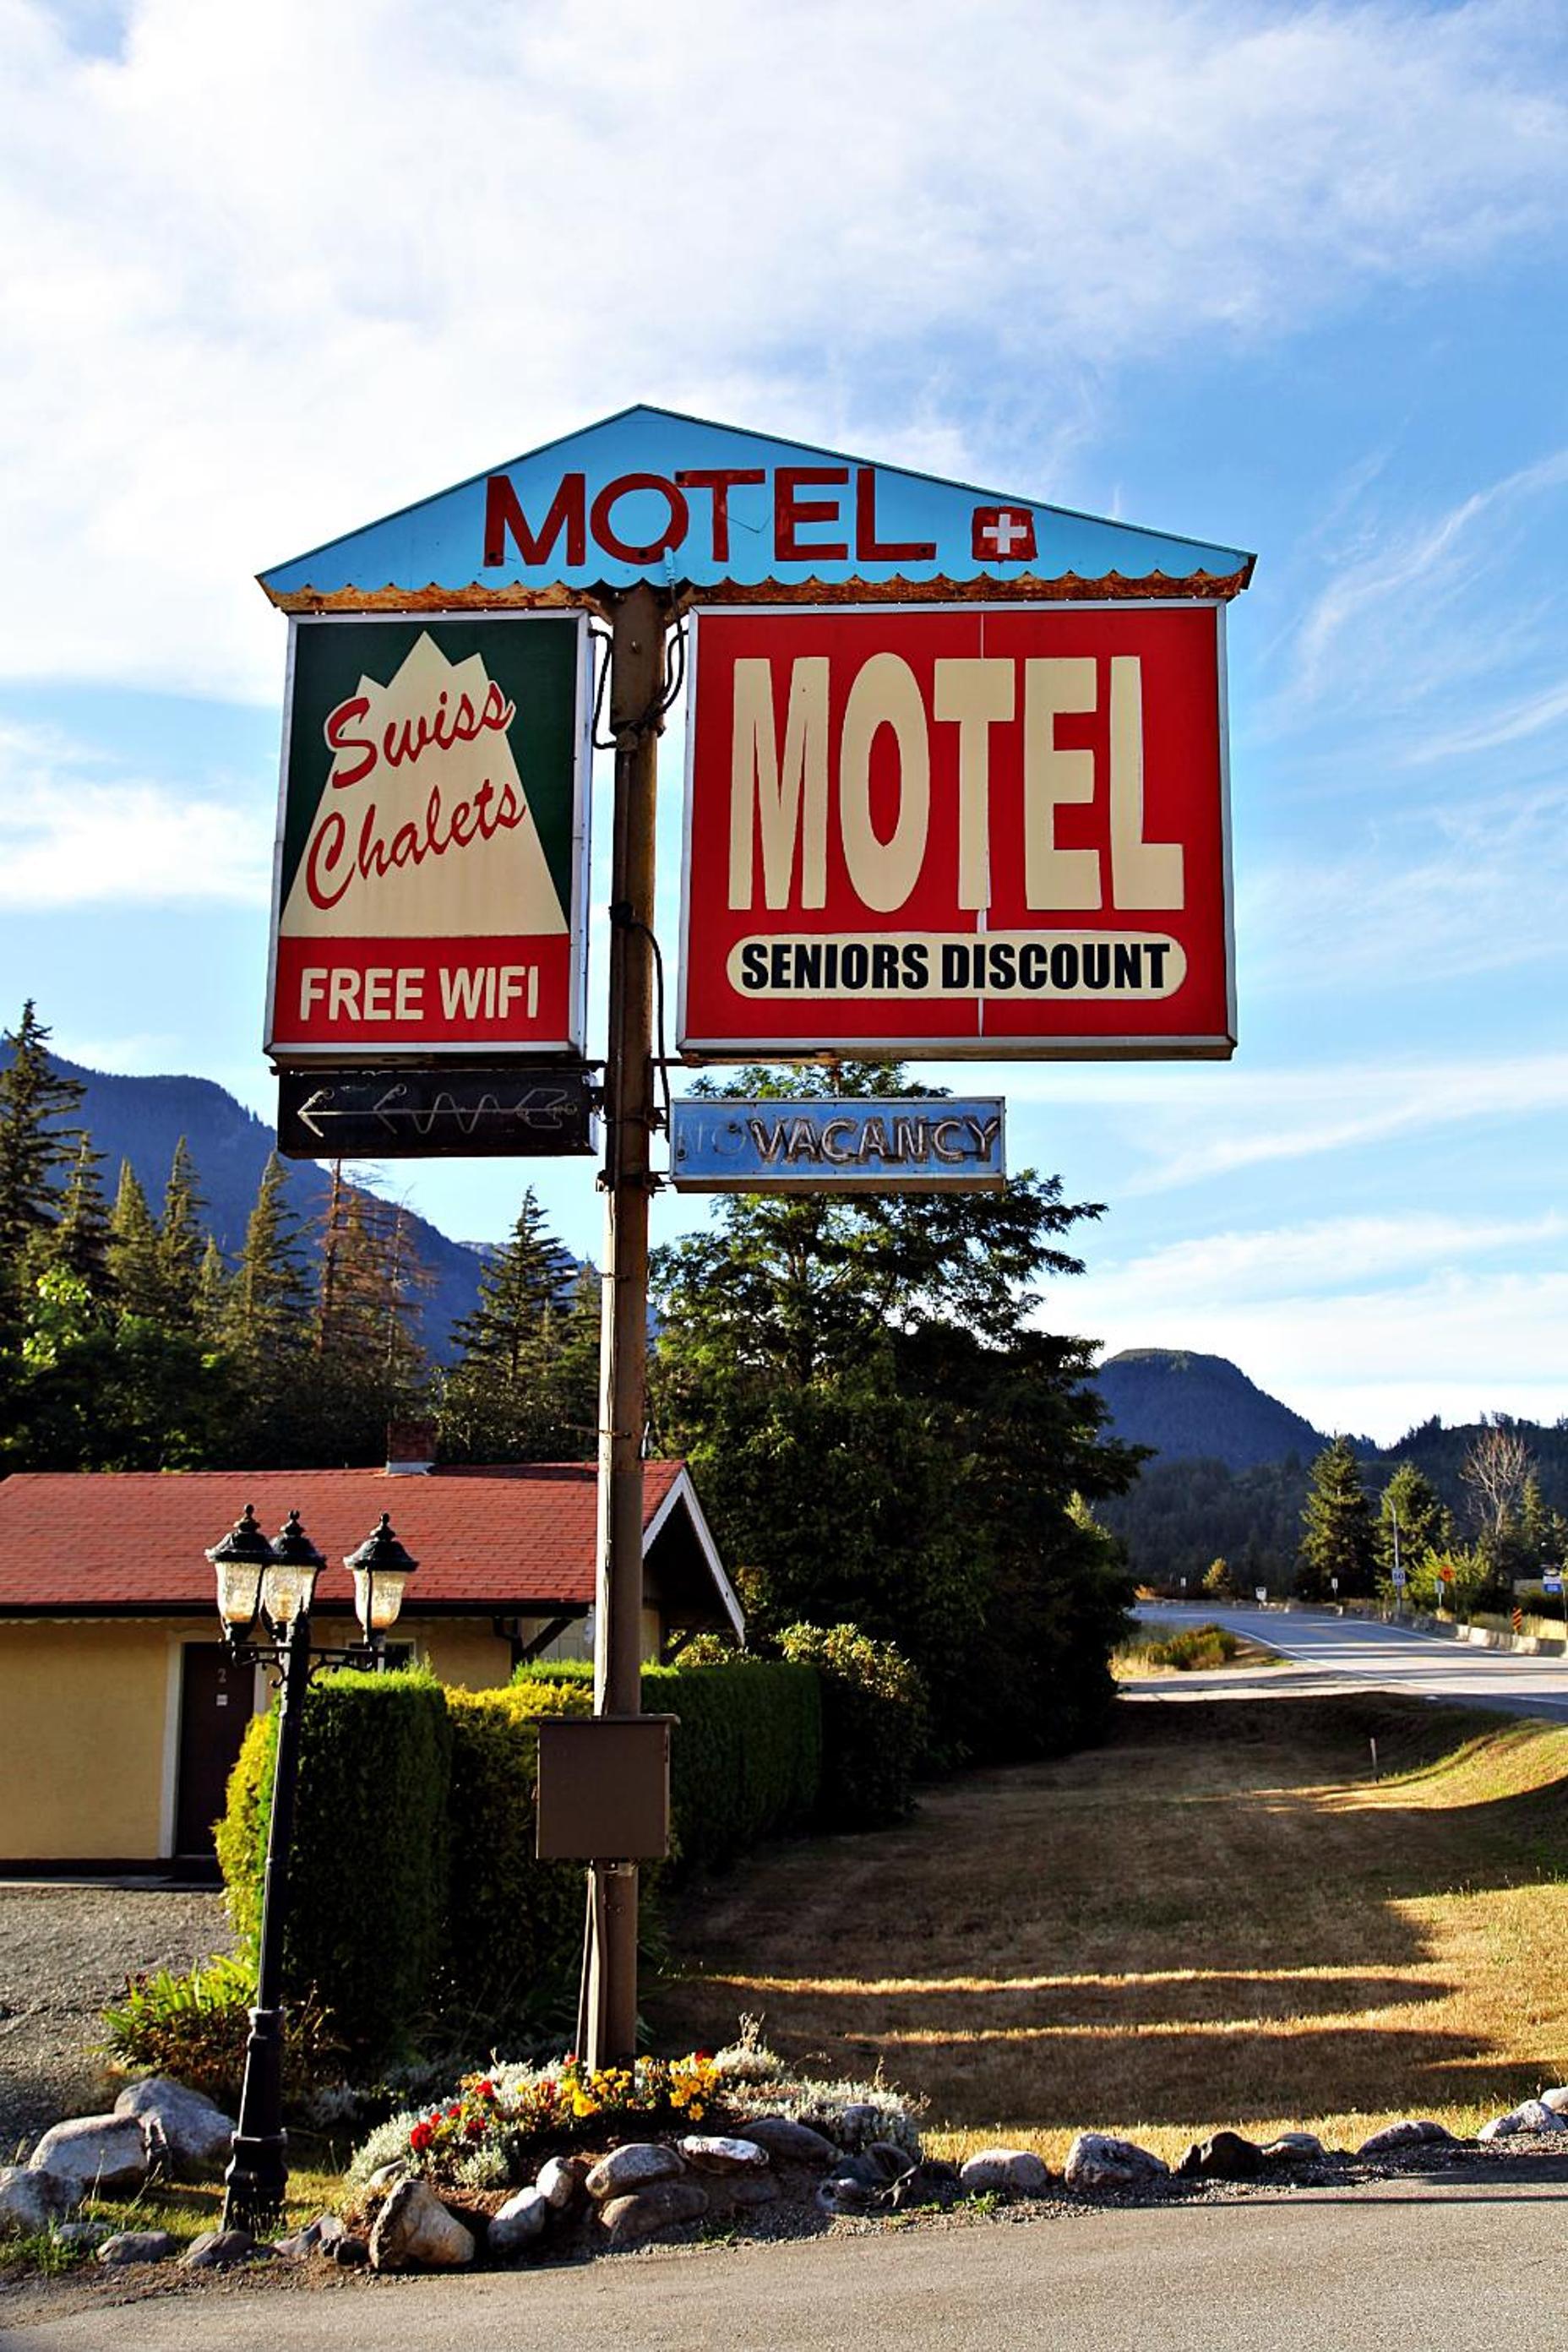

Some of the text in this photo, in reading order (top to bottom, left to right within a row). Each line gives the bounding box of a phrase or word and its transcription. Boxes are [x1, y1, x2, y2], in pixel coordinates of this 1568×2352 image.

[484, 467, 936, 566] MOTEL
[326, 682, 514, 789] Swiss
[727, 652, 1184, 913] MOTEL
[306, 778, 526, 910] Chalets
[300, 966, 539, 1021] FREE WIFI
[741, 943, 1171, 990] SENIORS DISCOUNT
[748, 1116, 1000, 1164] VACANCY
